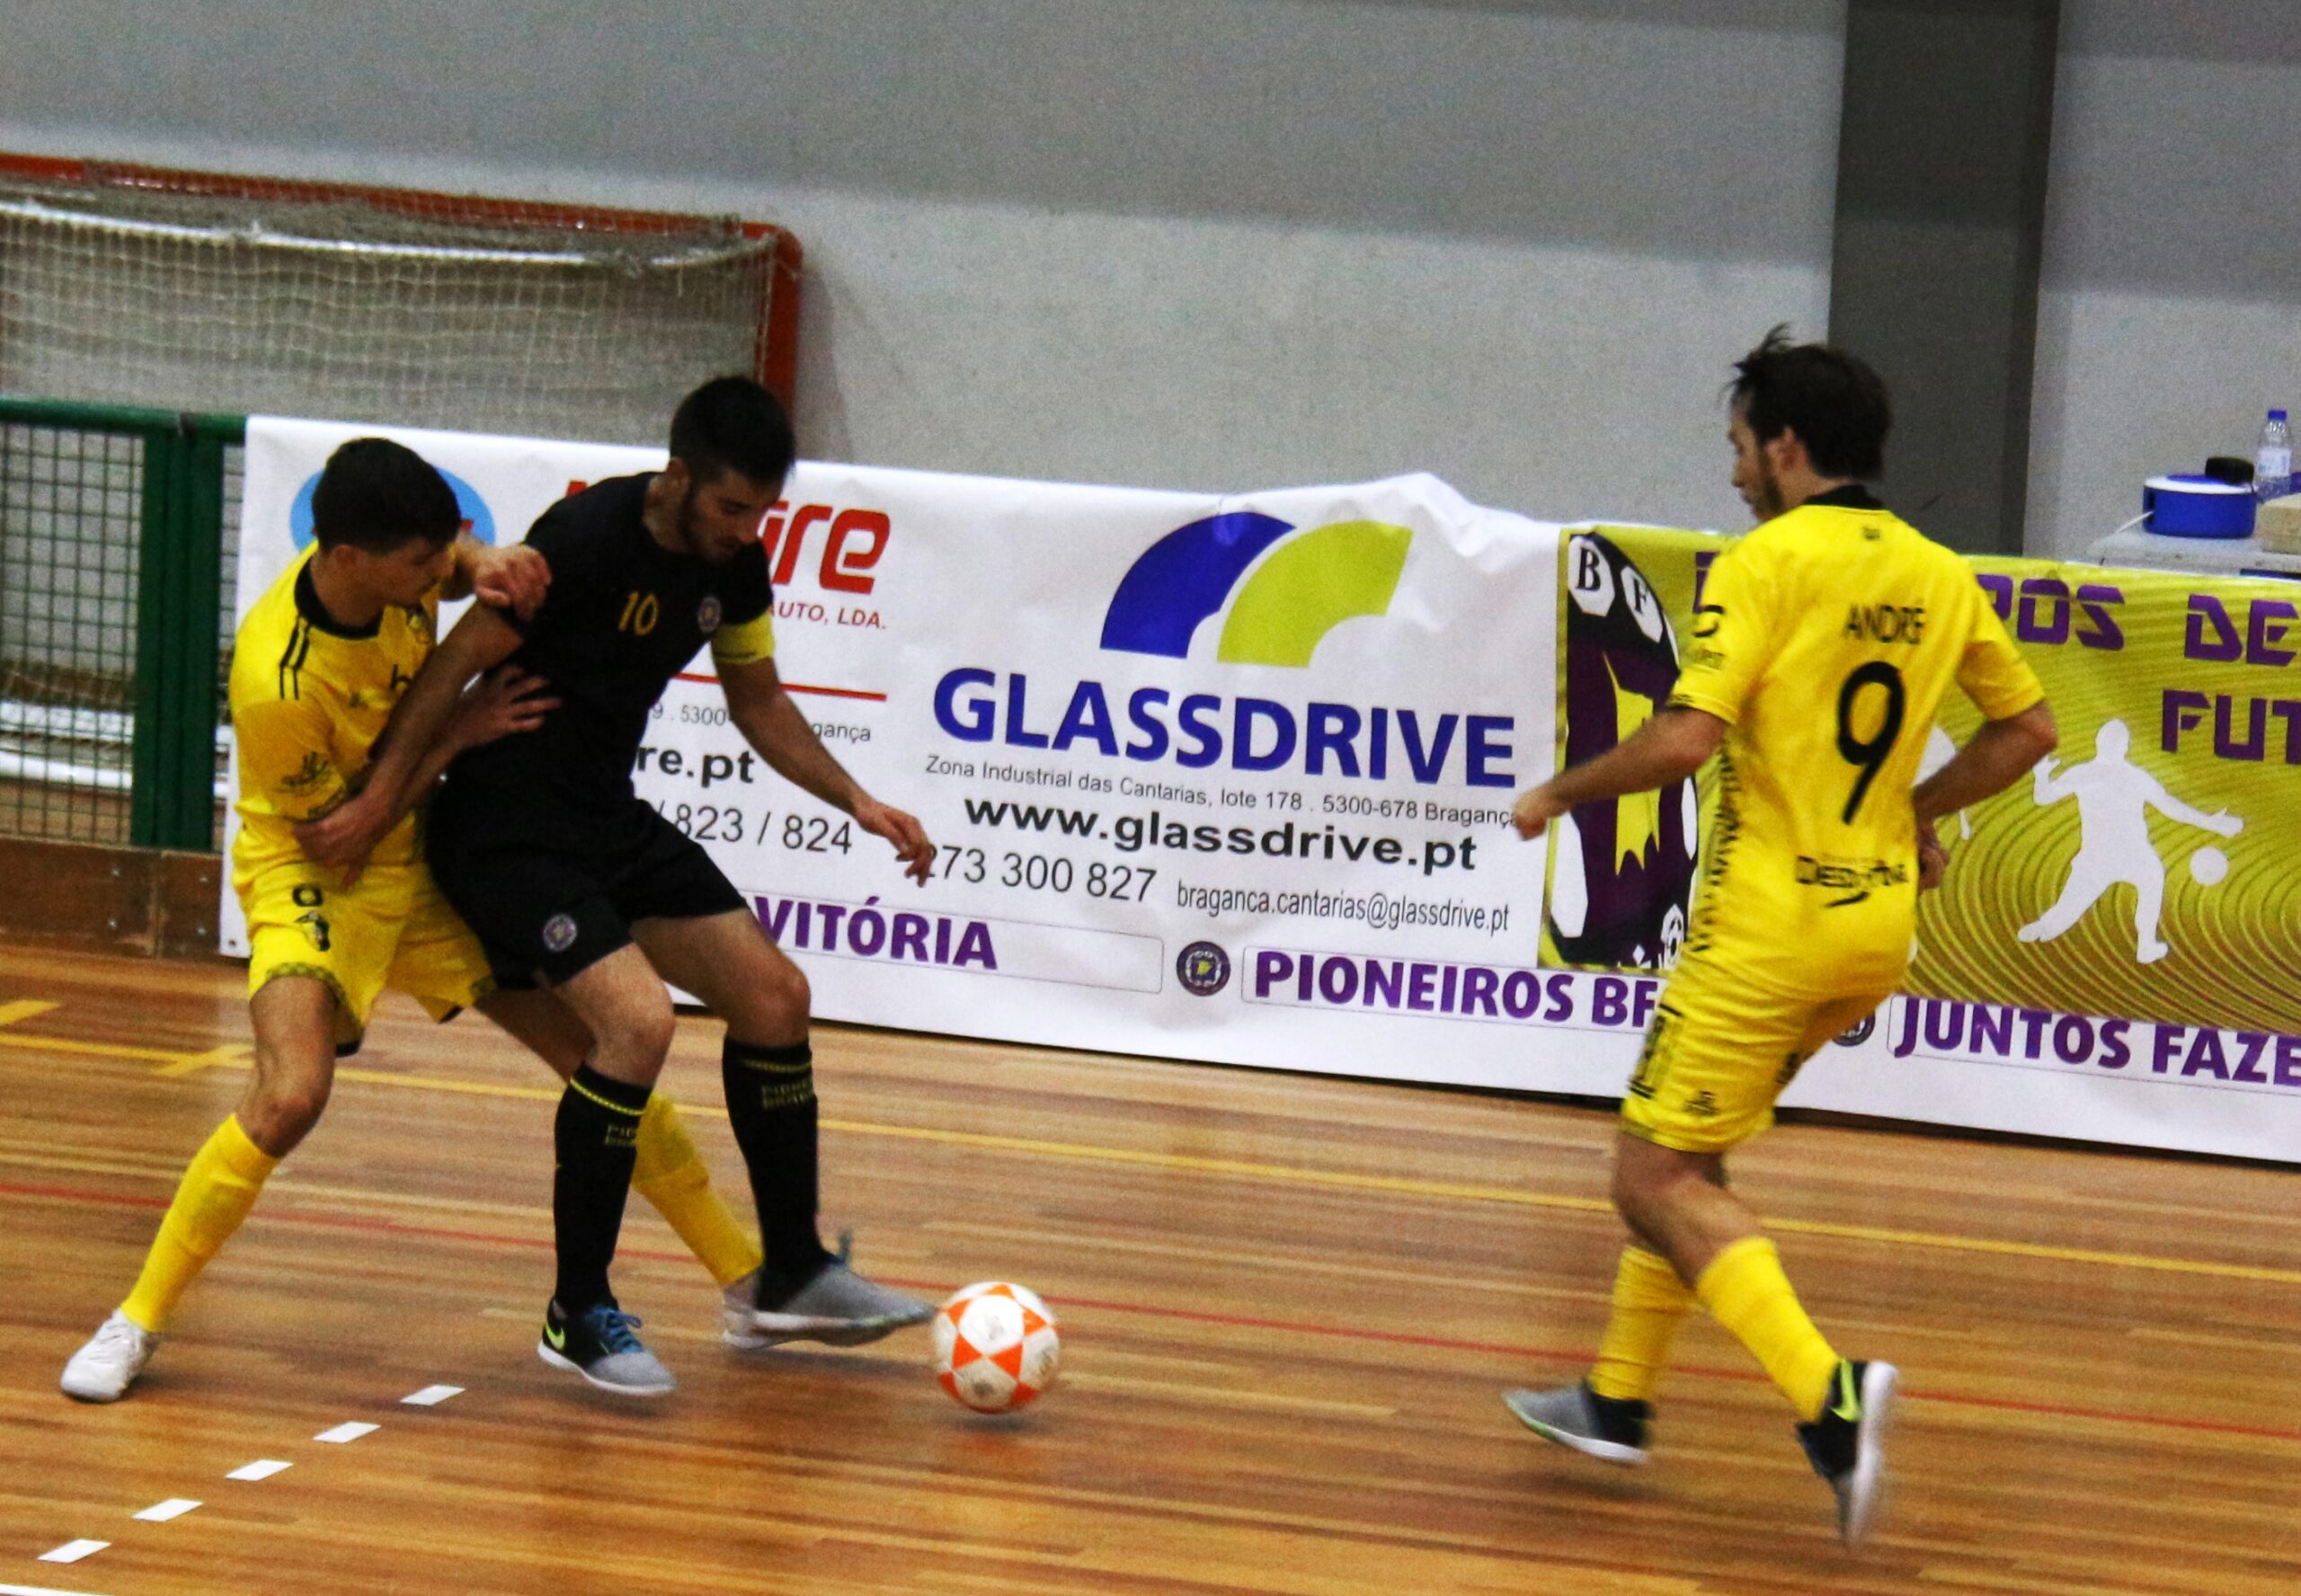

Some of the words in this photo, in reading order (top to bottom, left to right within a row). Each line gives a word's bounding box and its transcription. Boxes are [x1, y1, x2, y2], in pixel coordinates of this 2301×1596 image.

[1576, 546, 1602, 592] B
[617, 590, 659, 636] 10
[837, 607, 886, 630] LDA.
[2184, 593, 2300, 667] DE
[933, 667, 1516, 789] GLASSDRIVE
[1836, 661, 1906, 826] 9
[637, 745, 755, 788] re.pt
[926, 756, 974, 778] Zona
[982, 762, 1071, 788] Industrial
[1079, 774, 1112, 794] das
[1120, 777, 1213, 809] Cantarias,
[1221, 787, 1257, 809] lote
[1266, 792, 1302, 811] 178
[1322, 794, 1418, 820] 5300-678
[783, 815, 853, 856] 824
[964, 799, 1479, 877] www.glassdrive.pt
[1001, 852, 1073, 893] 300
[1087, 862, 1157, 903] 827
[1177, 878, 1510, 937] braganca.cantarias@glassdrive.pt
[753, 895, 999, 971] VITÓRIA
[1255, 950, 1576, 1024] PIONEIROS
[1591, 977, 1658, 1028] BF
[1893, 996, 2131, 1070] JUNTOS
[2151, 1024, 2301, 1087] FAZE
